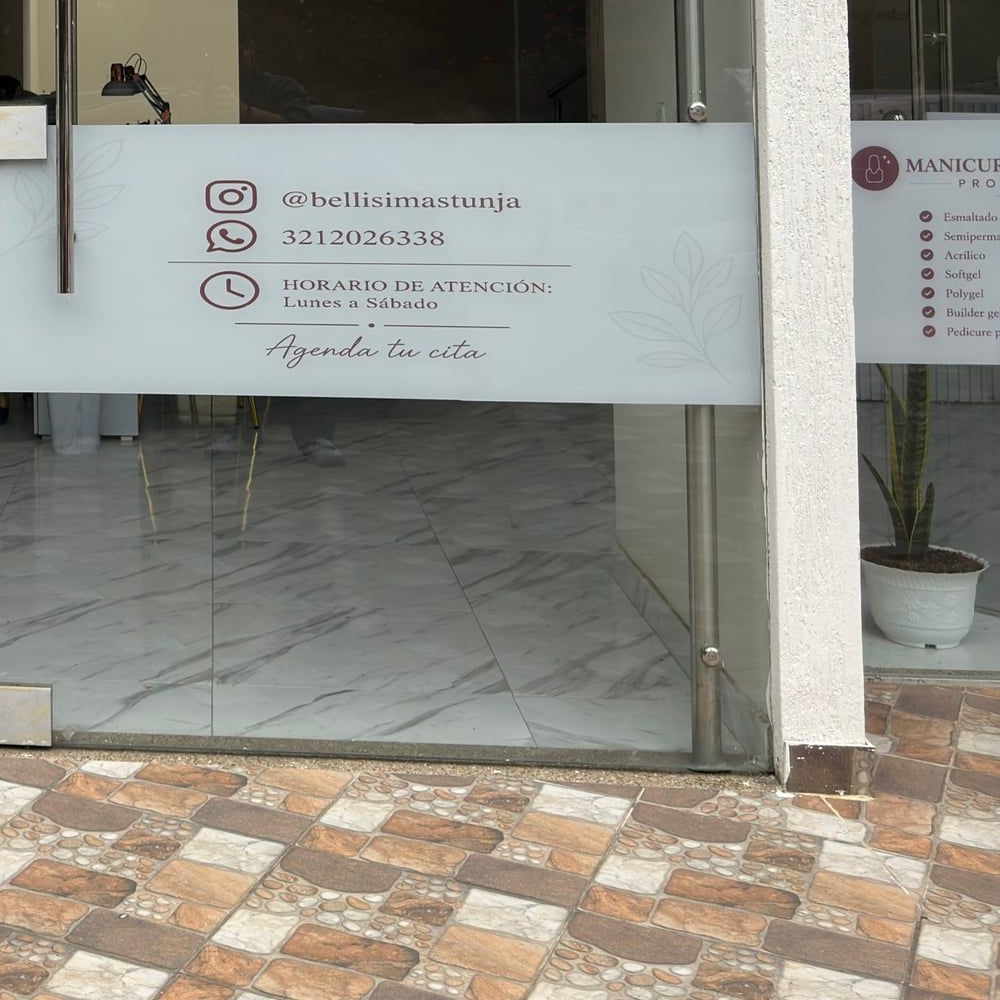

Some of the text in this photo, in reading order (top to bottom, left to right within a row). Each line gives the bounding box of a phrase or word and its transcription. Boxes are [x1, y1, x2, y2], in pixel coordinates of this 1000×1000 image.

[958, 178, 996, 188] PRO
[282, 190, 522, 213] @bellisimastunja
[943, 211, 998, 222] Esmaltado
[282, 229, 445, 247] 3212026338
[944, 269, 982, 282] Softgel
[283, 279, 553, 294] HORARIO DE ATENCIÓN:
[945, 288, 984, 301] Polygel
[283, 296, 439, 310] Lunes a Sábado
[946, 307, 985, 318] Builder
[947, 326, 992, 337] Pedicure
[265, 333, 487, 369] Agenda tu cita
